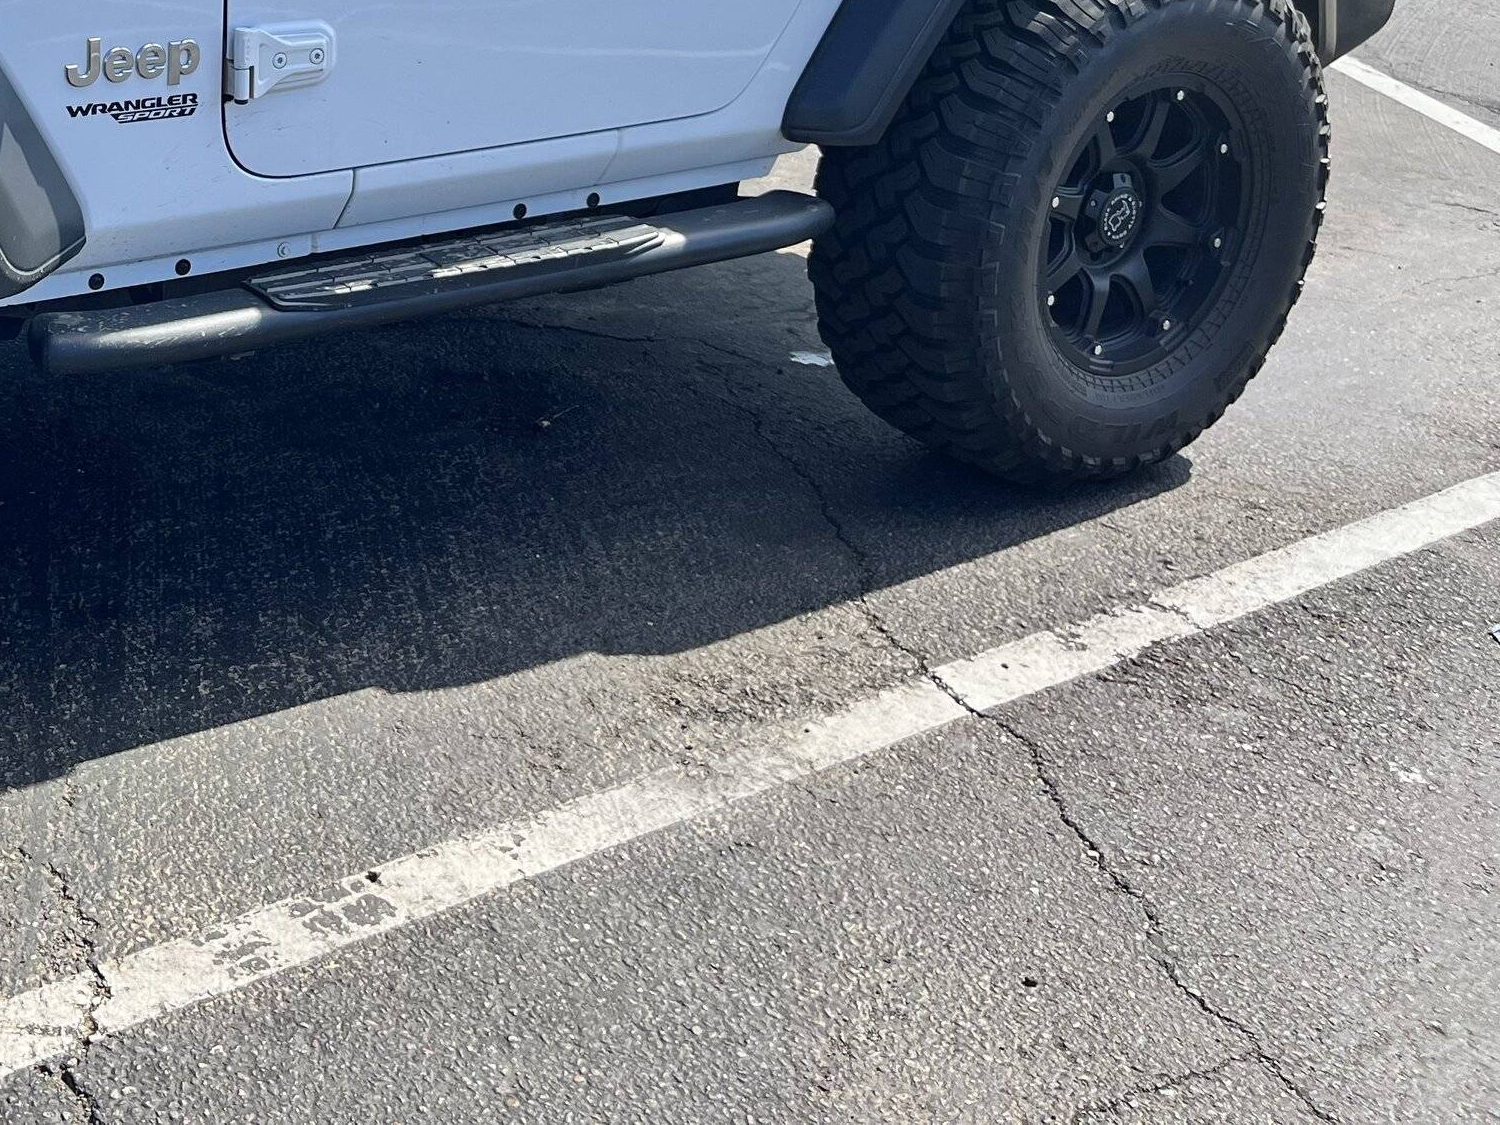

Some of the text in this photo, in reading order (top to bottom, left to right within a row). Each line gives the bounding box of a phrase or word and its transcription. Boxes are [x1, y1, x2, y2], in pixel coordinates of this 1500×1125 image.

[65, 37, 201, 87] Jeep
[66, 92, 199, 118] WRANGLER
[117, 107, 195, 123] SPORT
